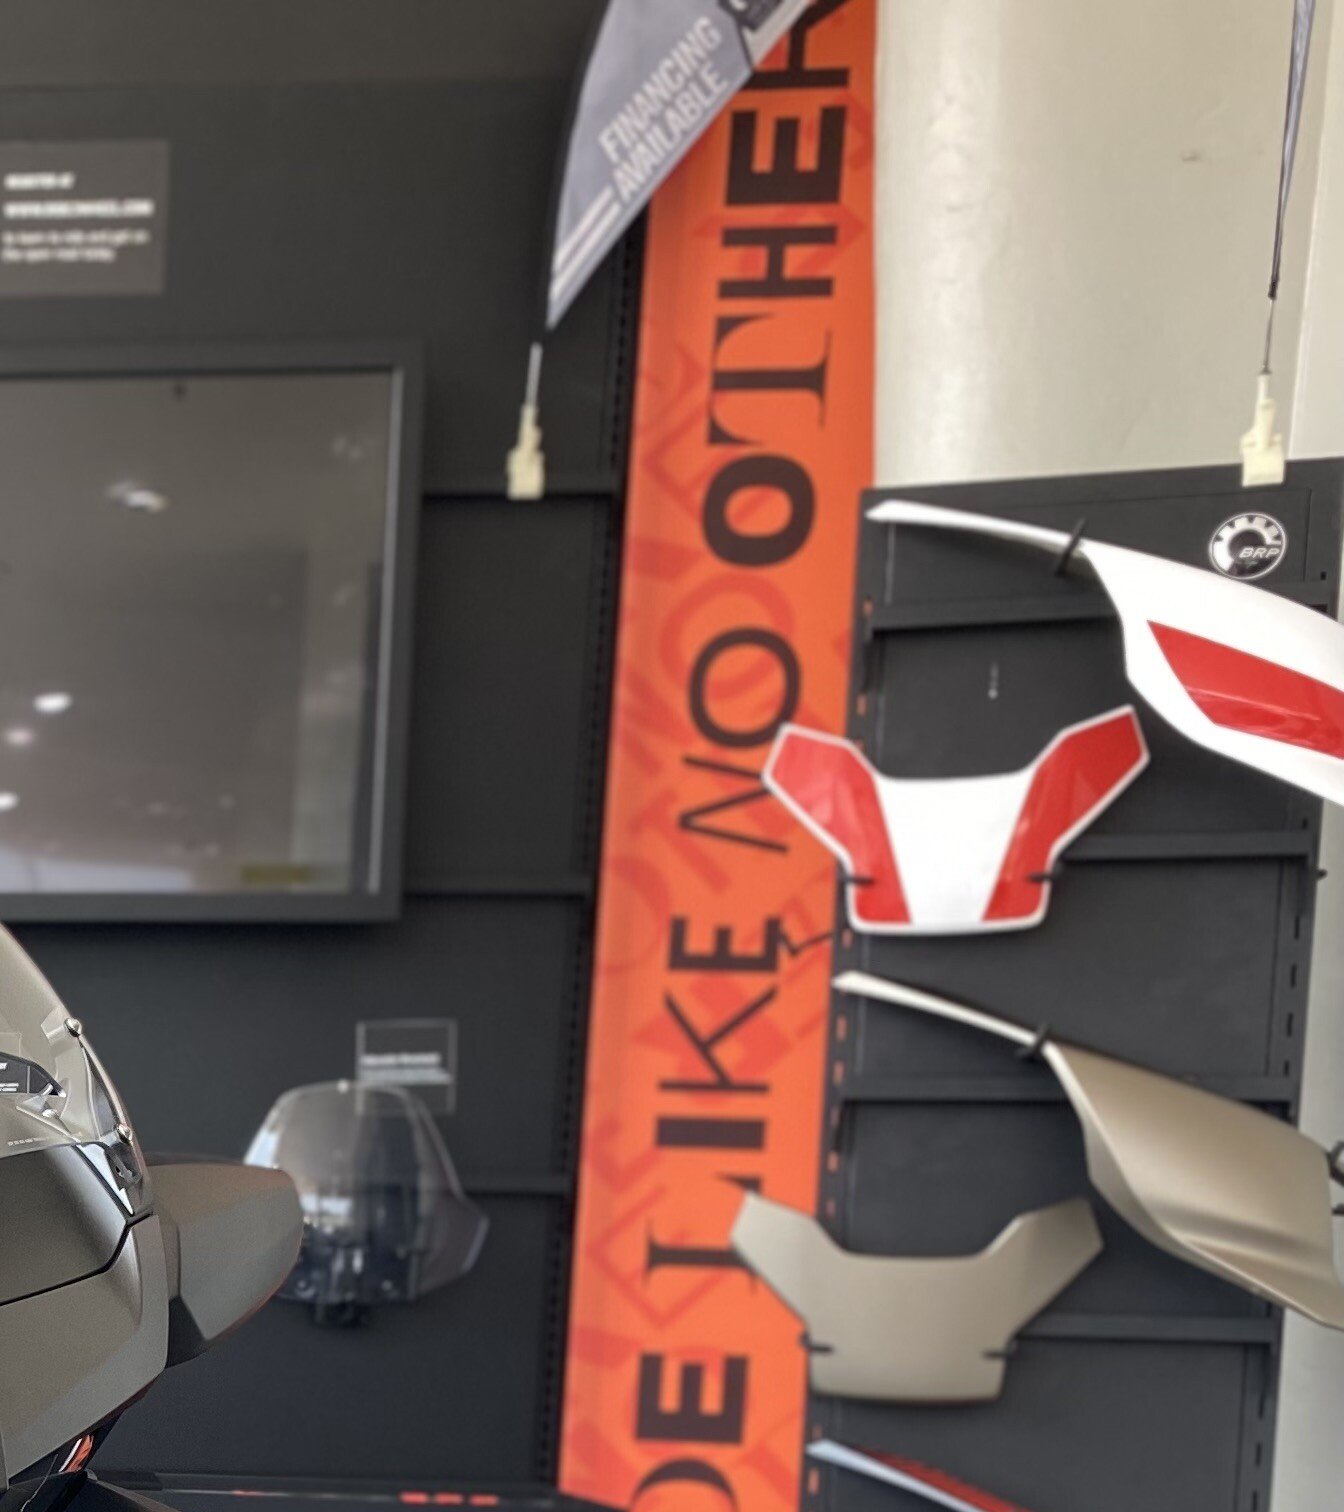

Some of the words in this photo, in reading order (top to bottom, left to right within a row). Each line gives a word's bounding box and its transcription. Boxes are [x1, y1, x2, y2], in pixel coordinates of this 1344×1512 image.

[598, 16, 723, 164] FINANCING
[612, 59, 730, 202] AVAILABLE
[1239, 547, 1280, 559] BRP
